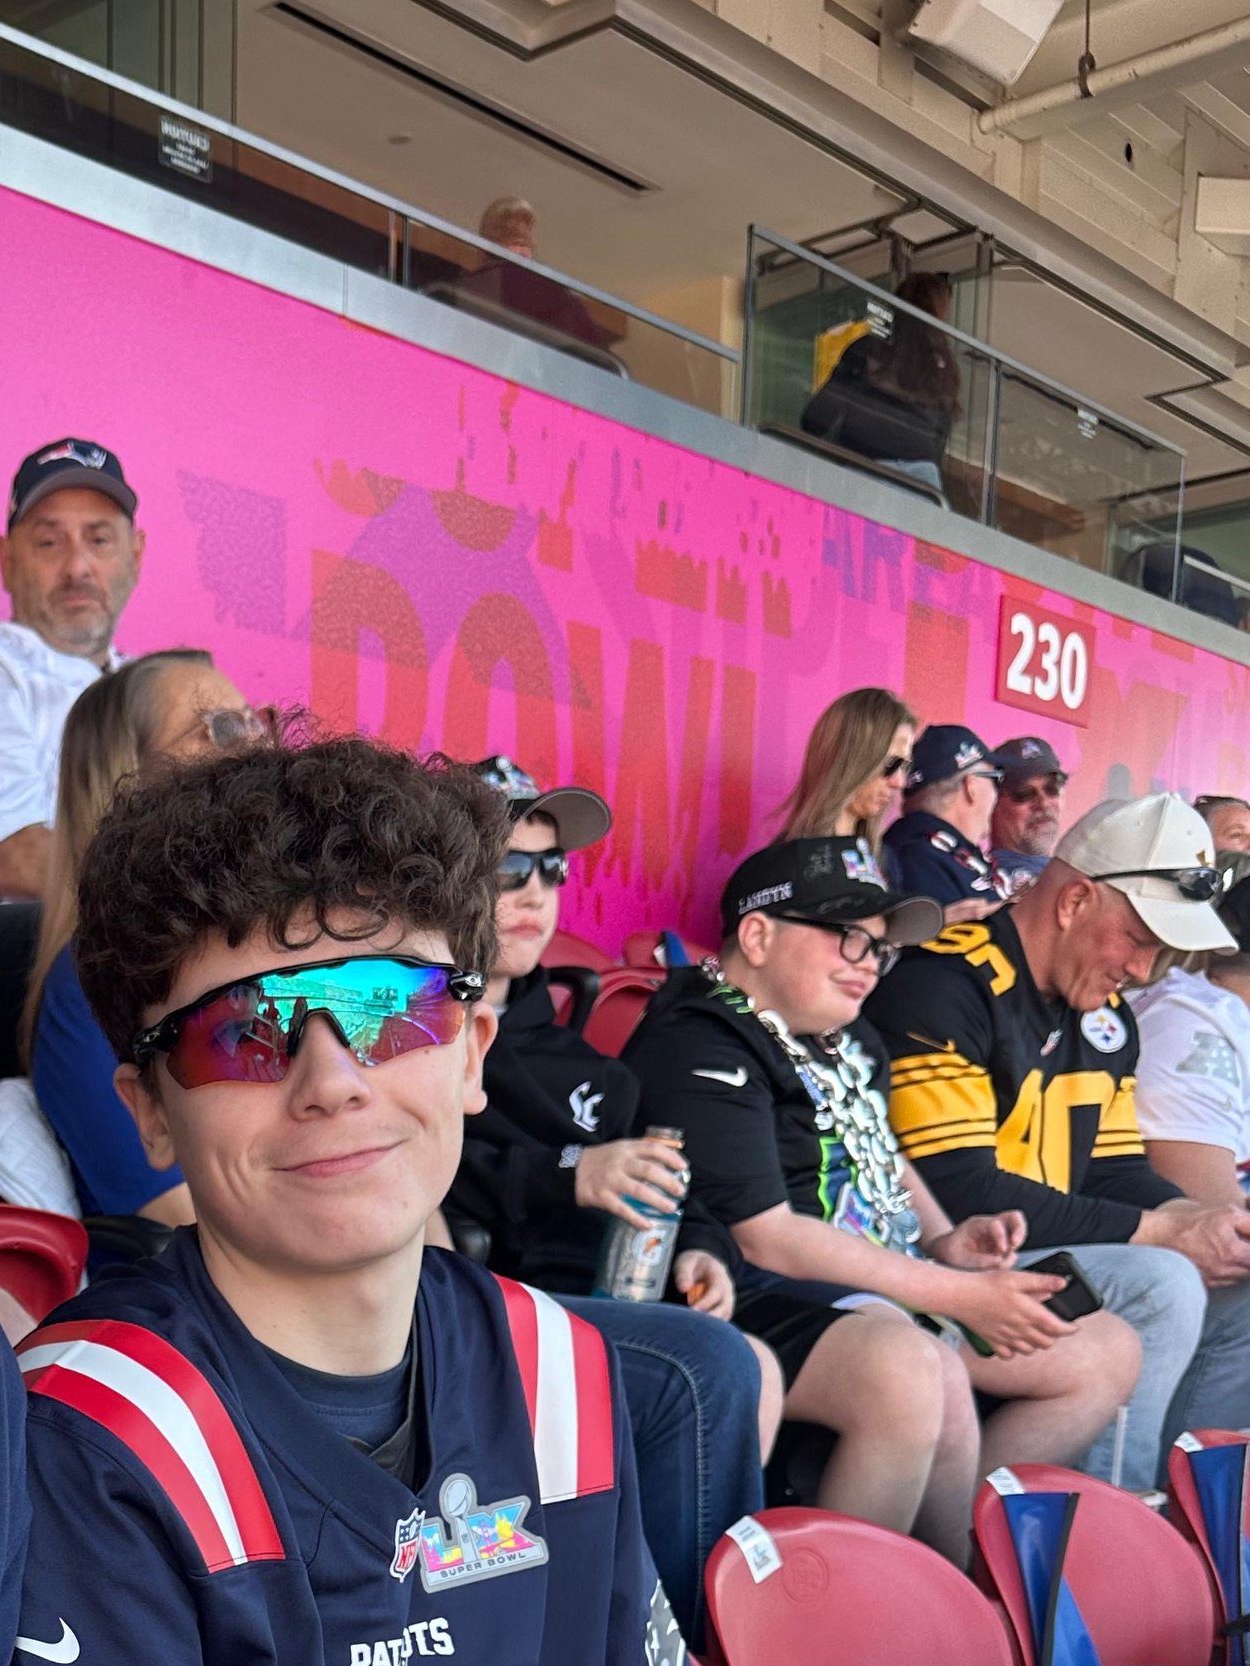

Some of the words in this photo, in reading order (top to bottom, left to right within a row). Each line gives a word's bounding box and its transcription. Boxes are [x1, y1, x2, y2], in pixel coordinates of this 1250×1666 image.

[1006, 611, 1088, 709] 230
[440, 1563, 482, 1578] SUPER
[488, 1553, 526, 1566] BOWL
